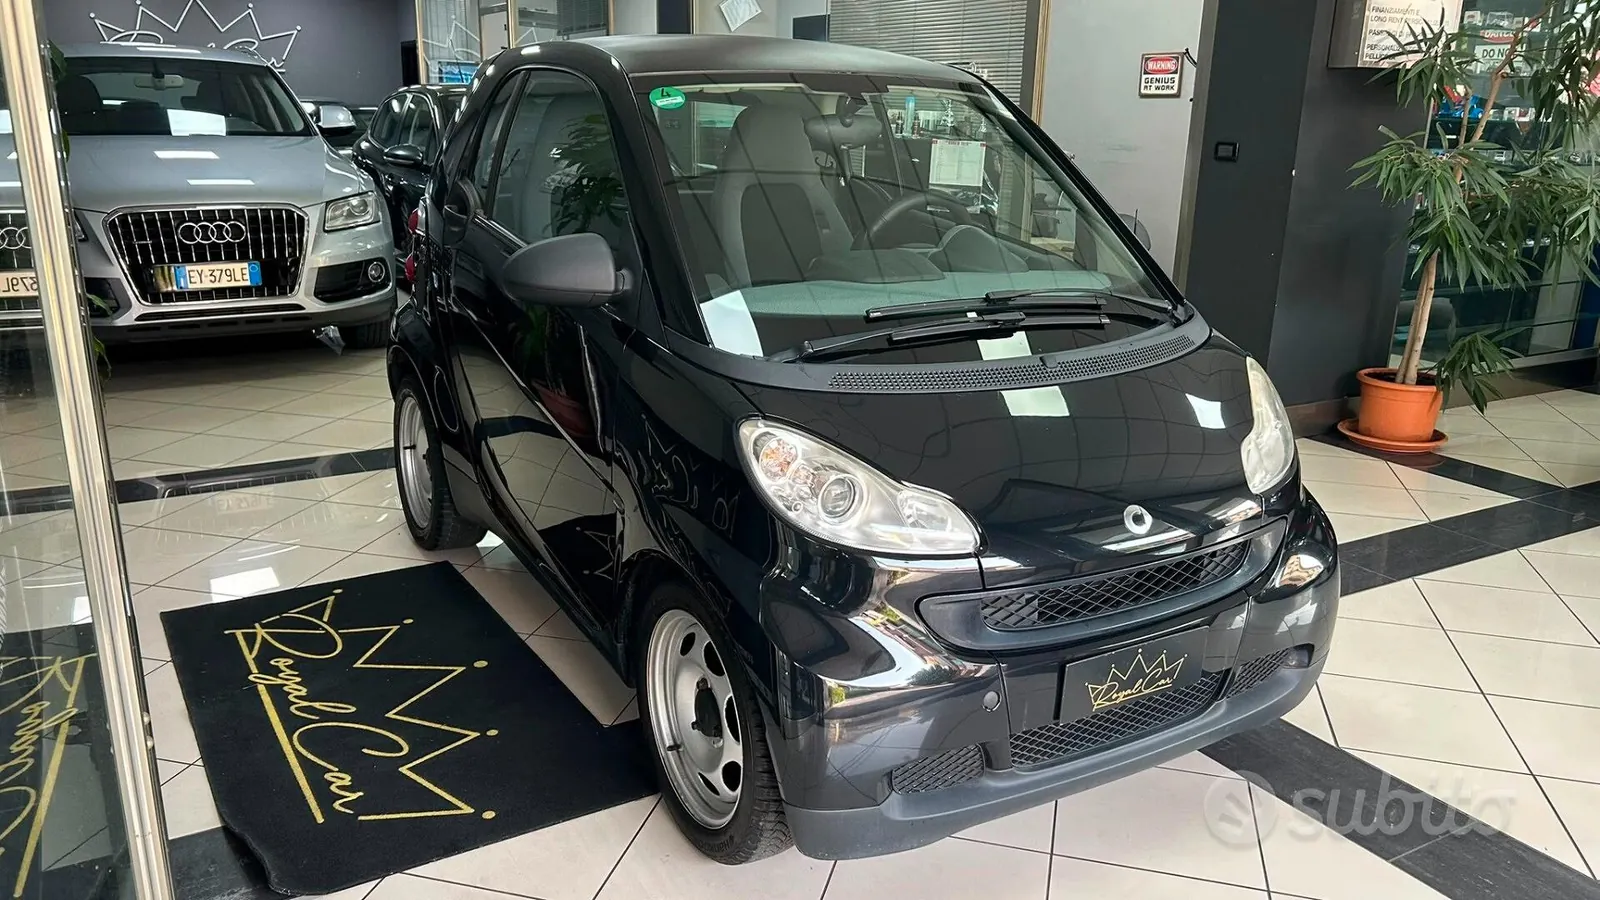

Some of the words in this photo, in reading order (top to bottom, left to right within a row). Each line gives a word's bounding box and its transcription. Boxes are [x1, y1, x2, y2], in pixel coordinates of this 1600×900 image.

[1370, 15, 1387, 23] LONG
[1482, 48, 1495, 58] DO
[1147, 60, 1176, 71] WARNING
[1092, 678, 1143, 711] Royal
[1141, 668, 1173, 692] Car
[224, 613, 357, 720] Royal
[292, 722, 410, 814] Car
